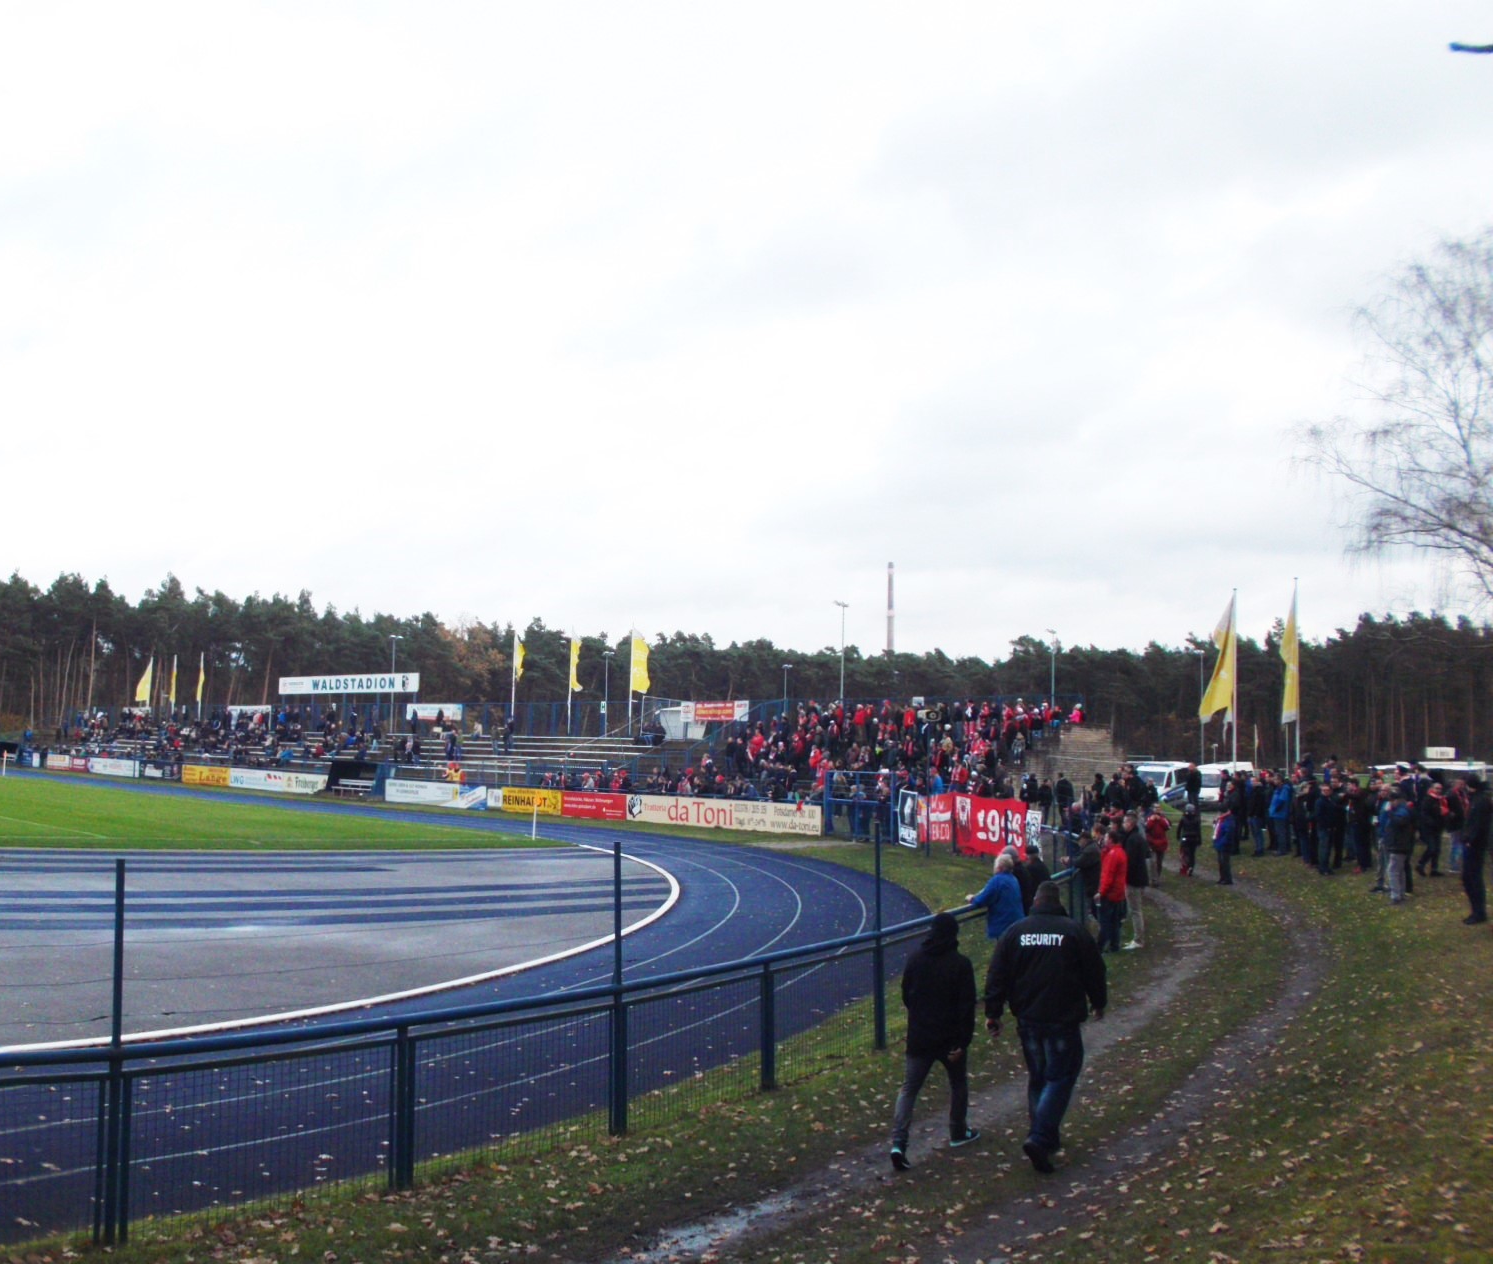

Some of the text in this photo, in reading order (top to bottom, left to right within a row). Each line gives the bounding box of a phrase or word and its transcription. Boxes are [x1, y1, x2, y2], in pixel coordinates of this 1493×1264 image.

[312, 677, 395, 691] WALDSTADION
[198, 770, 227, 784] Lange
[642, 803, 666, 813] Trattoria
[668, 798, 689, 823] da
[692, 801, 733, 826] Toni
[1020, 933, 1064, 946] SECURITY
